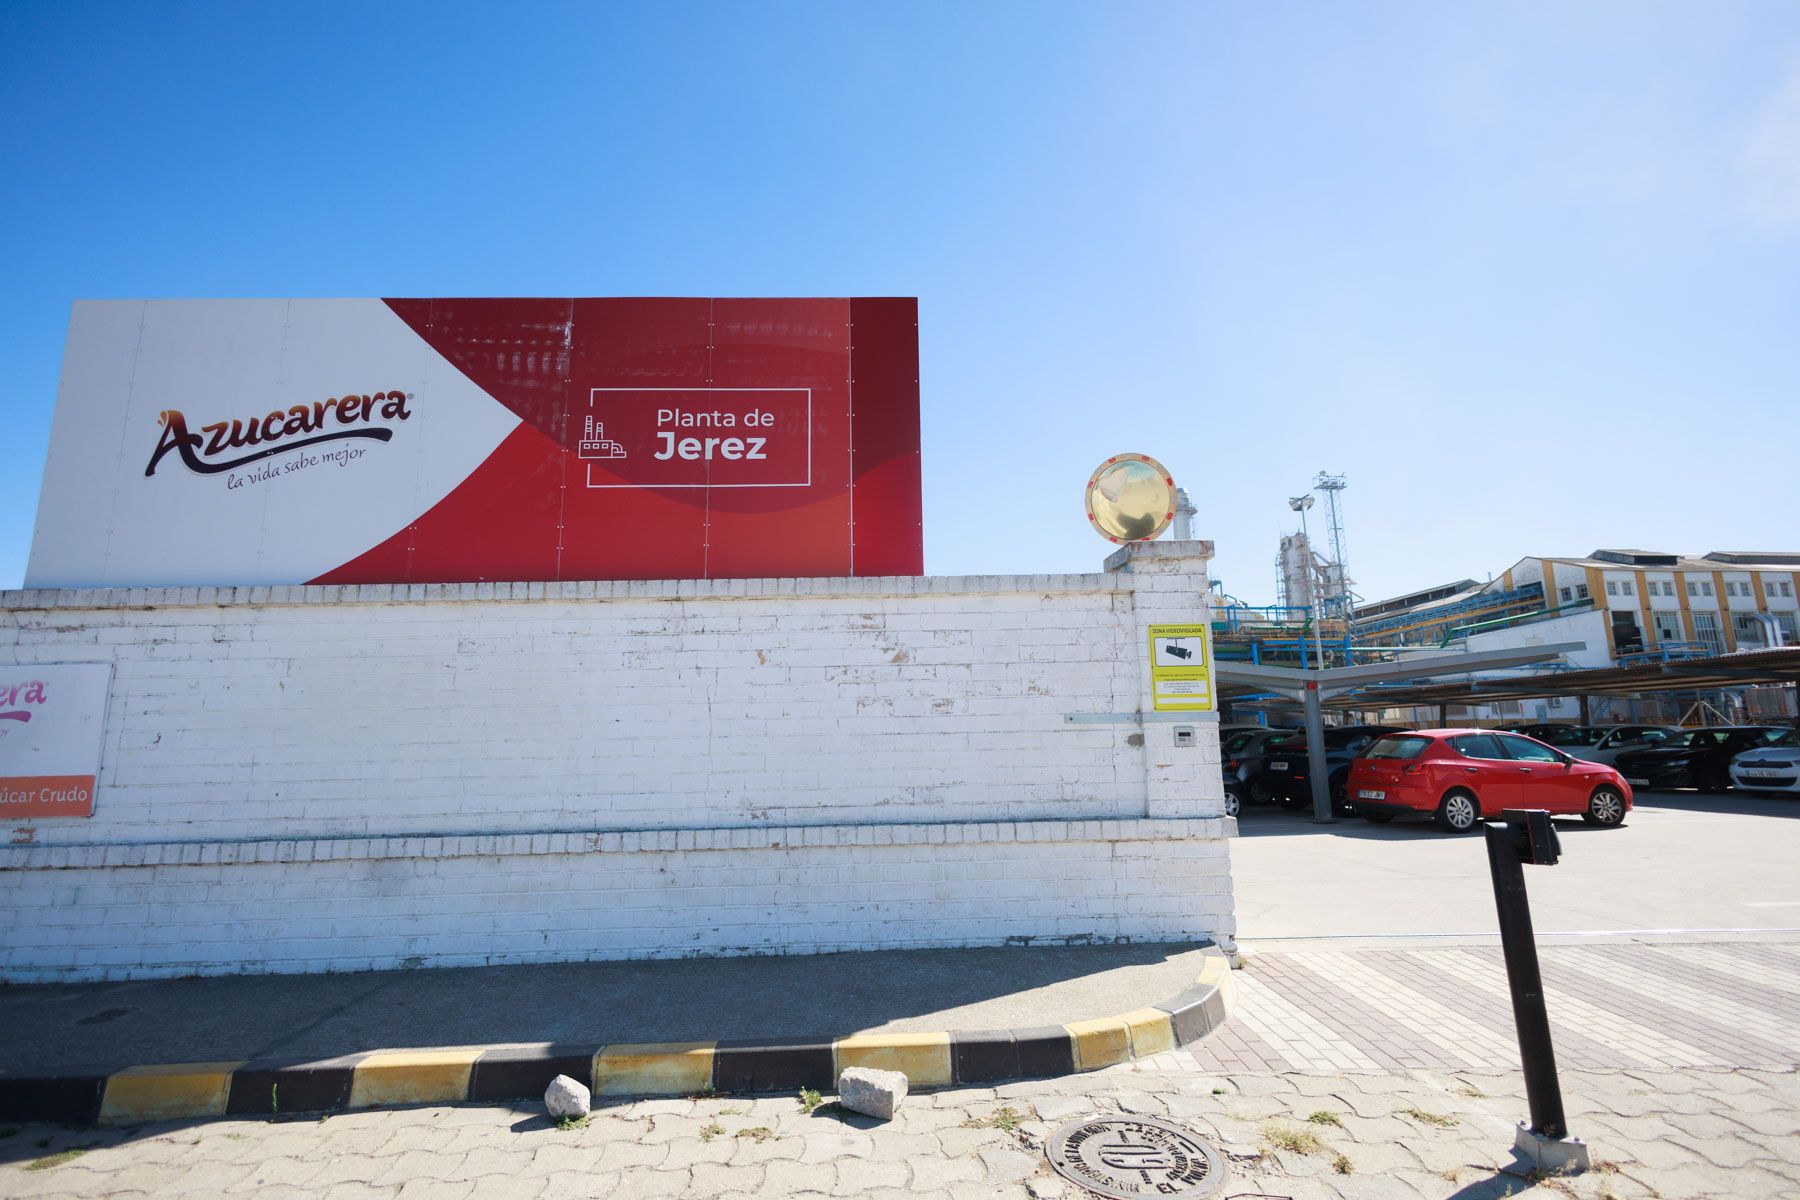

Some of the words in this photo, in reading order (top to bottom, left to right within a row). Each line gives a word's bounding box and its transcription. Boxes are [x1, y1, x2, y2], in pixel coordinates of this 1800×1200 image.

[657, 408, 736, 427] Planta
[744, 408, 775, 427] de
[145, 390, 411, 477] Azucarera
[654, 431, 767, 461] Jerez
[227, 473, 244, 490] la
[248, 461, 280, 485] vida
[284, 452, 319, 474] sabe
[322, 442, 367, 467] mejor
[40, 785, 88, 803] Crudo
[1064, 1143, 1080, 1153] LA
[1064, 1154, 1084, 1163] DE
[1156, 1182, 1182, 1194] EL
